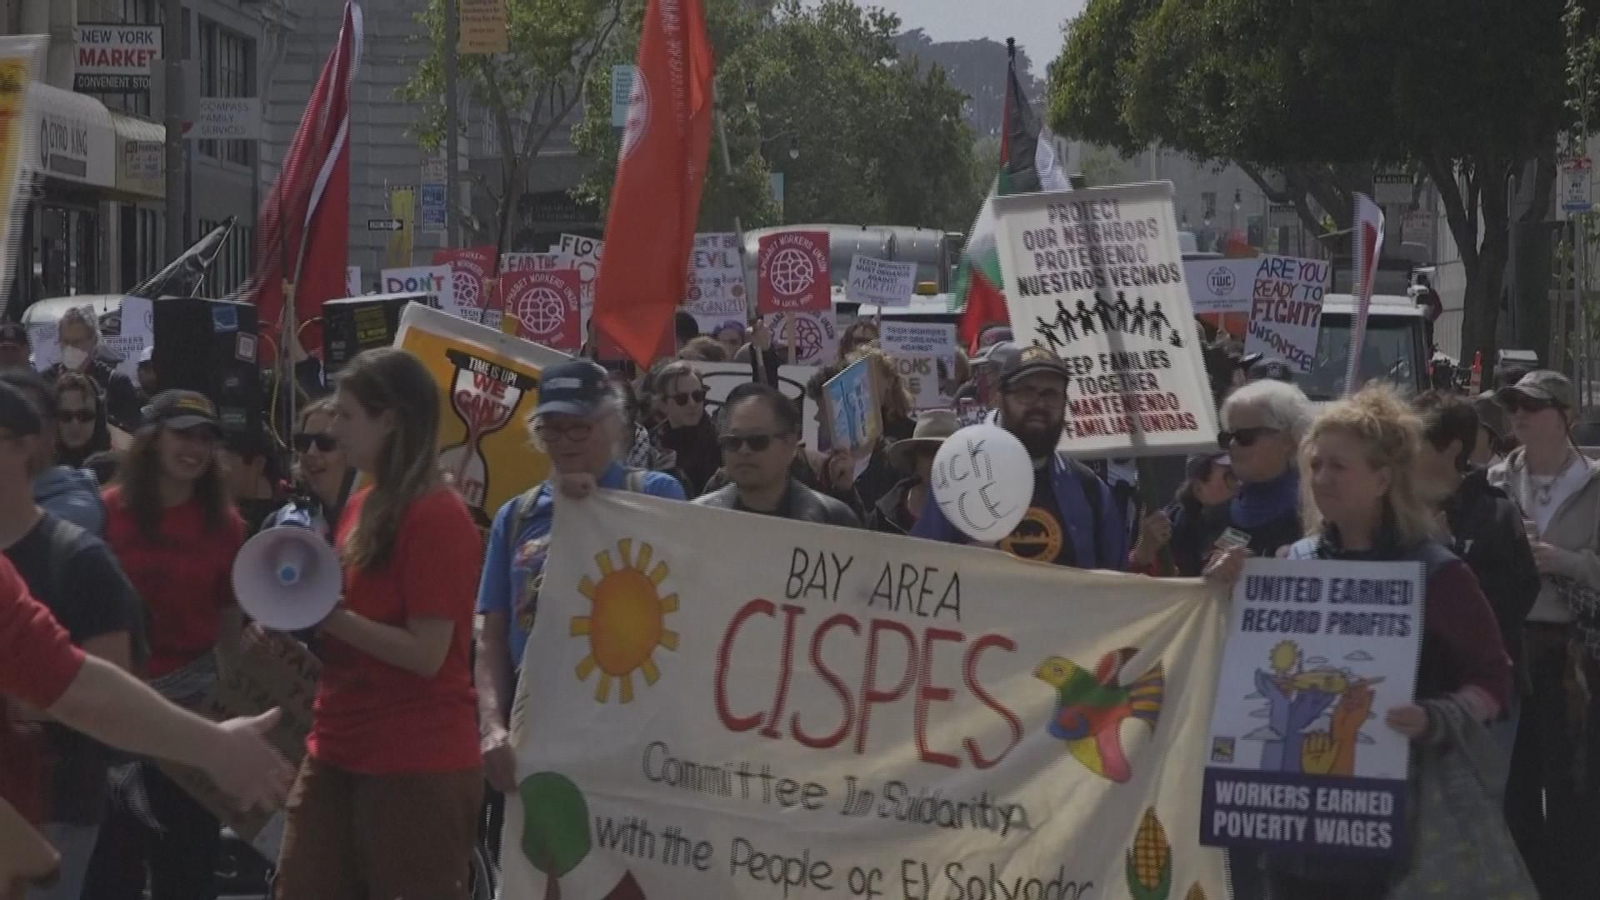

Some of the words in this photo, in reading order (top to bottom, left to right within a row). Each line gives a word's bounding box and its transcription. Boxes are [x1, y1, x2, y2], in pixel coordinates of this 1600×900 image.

[81, 30, 112, 44] NEW
[118, 31, 154, 45] YORK
[79, 49, 157, 67] MARKET
[79, 75, 130, 89] CONVENIENT
[200, 102, 249, 112] COMPASS
[200, 113, 234, 124] FAMILY
[50, 122, 68, 152] GYRO
[70, 131, 88, 158] KING
[200, 124, 246, 136] SERVICES
[1048, 198, 1122, 225] PROTECT
[1022, 229, 1058, 252] OUR
[1063, 217, 1159, 246] NEIGHBORS
[694, 250, 734, 268] EVIL
[779, 233, 813, 251] WORKERS
[812, 242, 831, 272] UNION
[1034, 242, 1147, 273] PROTEGIENDO
[386, 274, 446, 293] DON'T
[1017, 267, 1106, 298] NUESTROS
[1107, 261, 1182, 290] VECINOS
[1211, 276, 1232, 288] TWC
[1256, 257, 1295, 281] ARE
[1297, 261, 1329, 283] YOU
[528, 272, 566, 289] WORKERS
[562, 286, 580, 311] UNION
[1252, 279, 1296, 299] READY
[1303, 284, 1324, 301] TO
[818, 312, 836, 341] UNION
[1251, 298, 1322, 328] FIGHT?
[469, 357, 491, 377] TIME
[491, 366, 502, 380] IS
[501, 371, 518, 386] UP!
[1062, 355, 1095, 379] EEP
[1098, 349, 1173, 374] FAMILIES
[472, 374, 506, 398] WE
[1076, 371, 1161, 397] TOGETHER
[1068, 391, 1181, 418] MANTENIENDO
[1065, 414, 1138, 441] FAMILIAS
[1140, 410, 1199, 435] UNIDAS
[786, 546, 854, 603] BAY
[867, 562, 962, 622] AREA
[1244, 575, 1324, 604] UNITED
[1326, 577, 1415, 607] EARNED
[1240, 607, 1321, 635] RECORD
[1324, 610, 1412, 638] PROFITS
[713, 597, 1024, 770] CISPES
[641, 740, 830, 812] Committee
[841, 775, 875, 817] In
[1215, 779, 1310, 811] WORKERS
[1316, 786, 1395, 817] EARNED
[1212, 808, 1309, 842] POVERTY
[1314, 813, 1393, 850] WAGES
[660, 825, 714, 873] the
[729, 837, 834, 899] People
[847, 866, 884, 896] of
[900, 857, 930, 900] El
